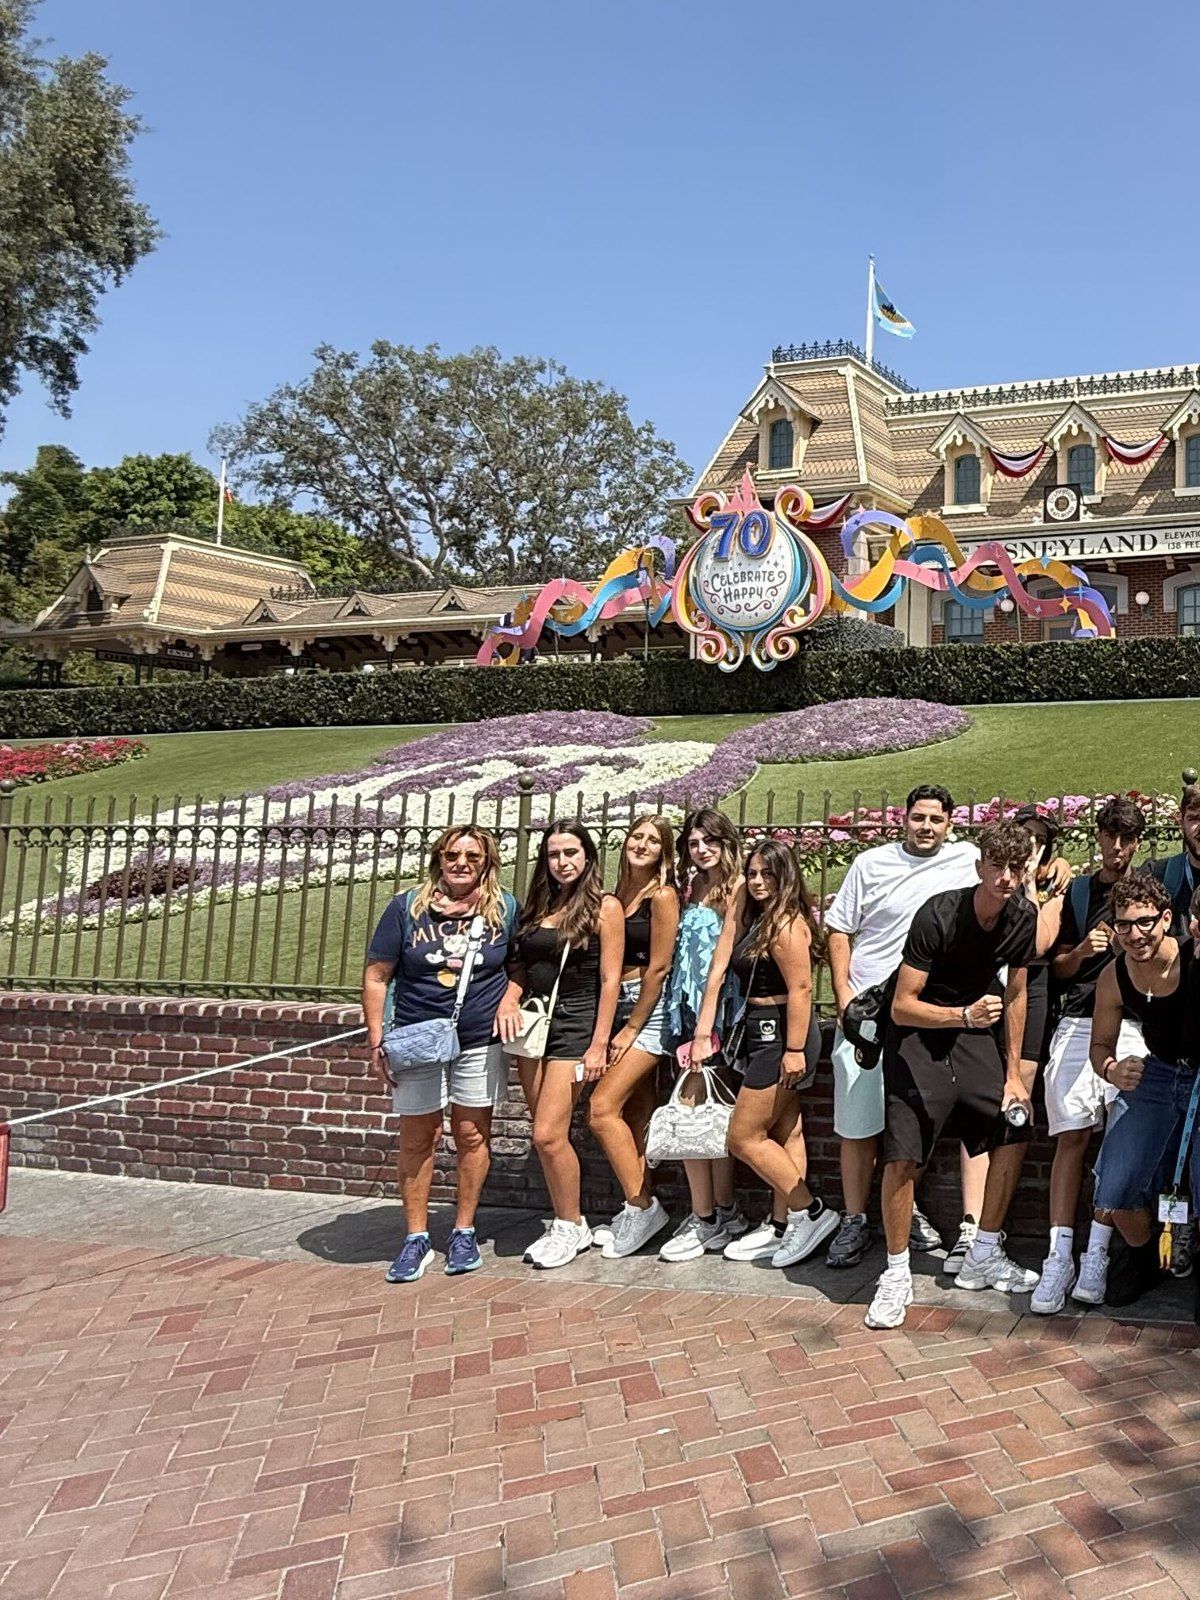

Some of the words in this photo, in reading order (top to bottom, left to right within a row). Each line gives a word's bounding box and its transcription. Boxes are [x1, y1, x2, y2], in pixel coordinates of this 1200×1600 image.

[710, 511, 774, 561] 70
[978, 533, 1158, 560] SNEYLAND
[1168, 541, 1181, 550] 138
[711, 571, 775, 592] CELEBRATE
[723, 586, 764, 604] HAPPY
